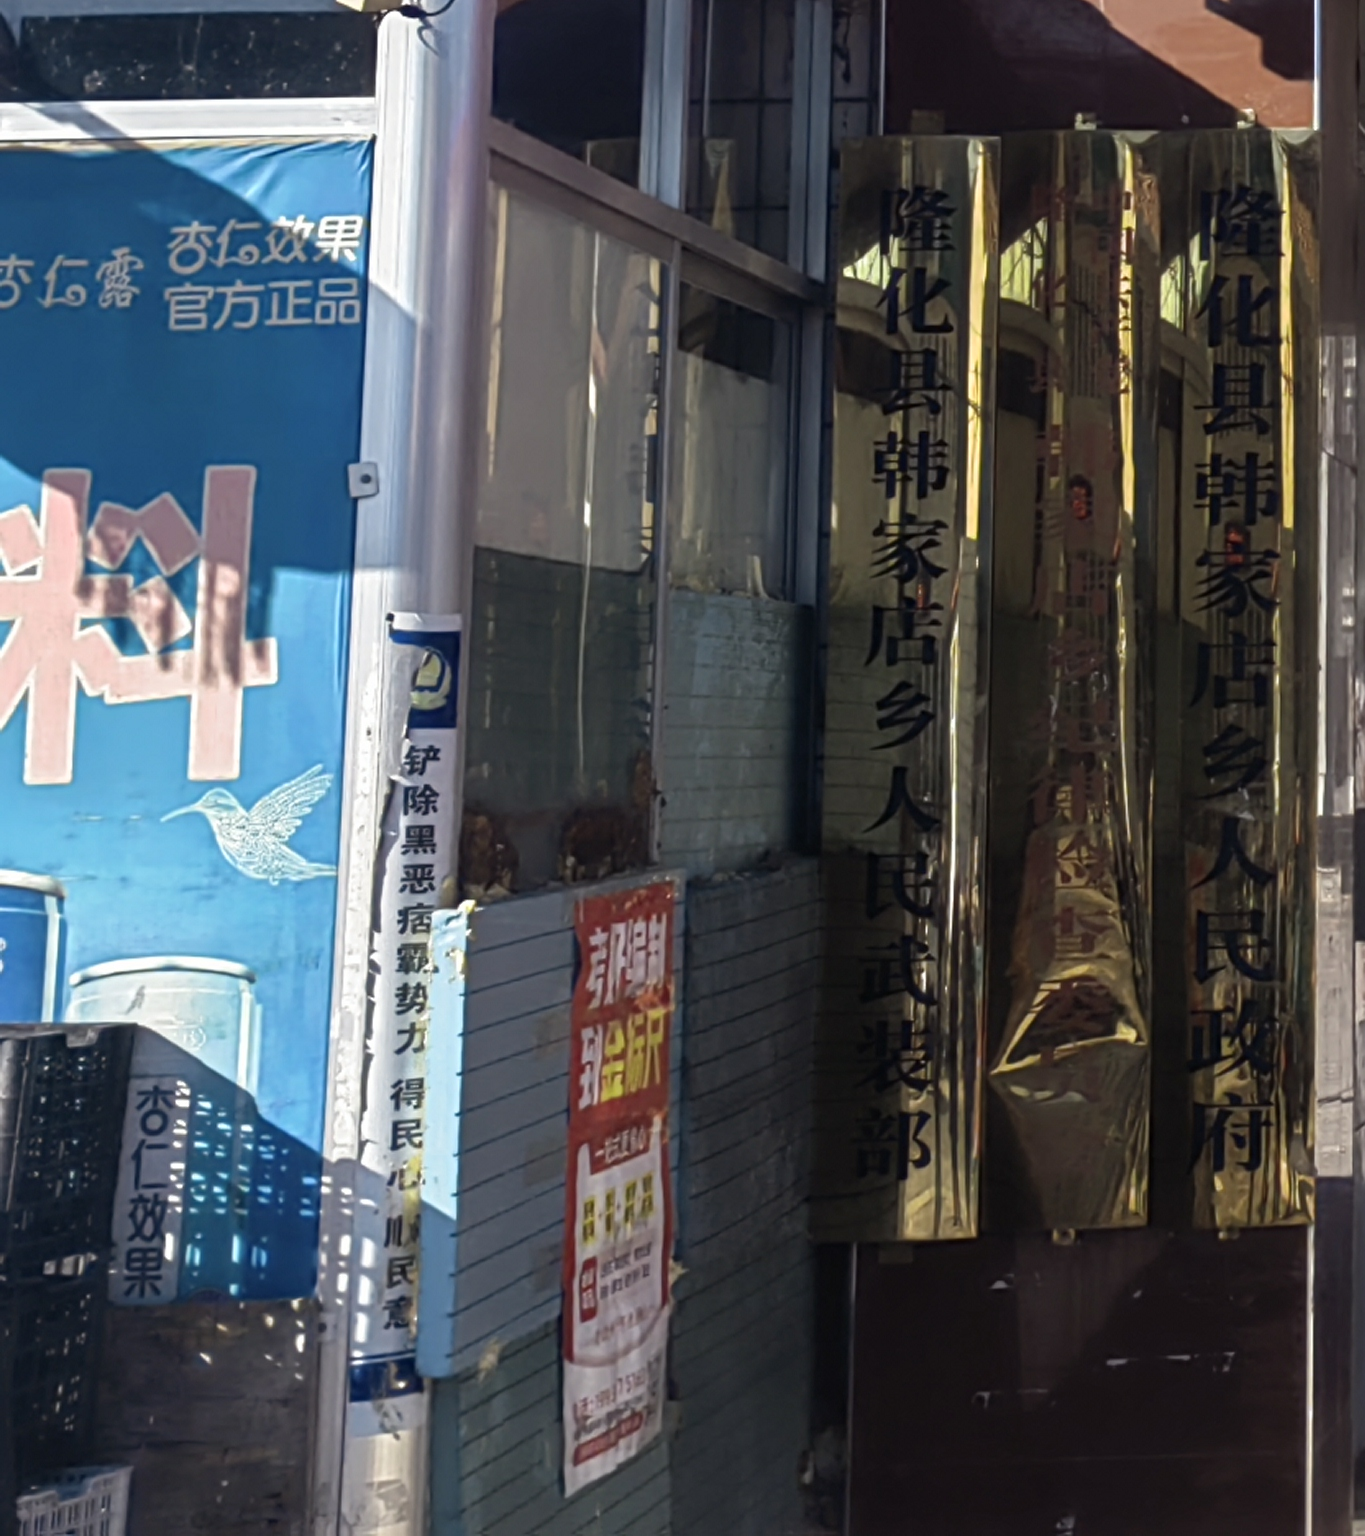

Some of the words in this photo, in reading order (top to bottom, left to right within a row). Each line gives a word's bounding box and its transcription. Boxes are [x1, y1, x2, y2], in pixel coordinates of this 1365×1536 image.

[164, 277, 361, 332] 官方正品
[167, 215, 364, 276] 杏仁效果
[851, 185, 957, 1181] 隆化县韩家店乡人民武装部
[1187, 185, 1286, 1174] 隆化县韩家店乡人民政府
[394, 745, 441, 1055] 铲除黑恶痞霸势力
[123, 1084, 176, 1298] 杏仁效果
